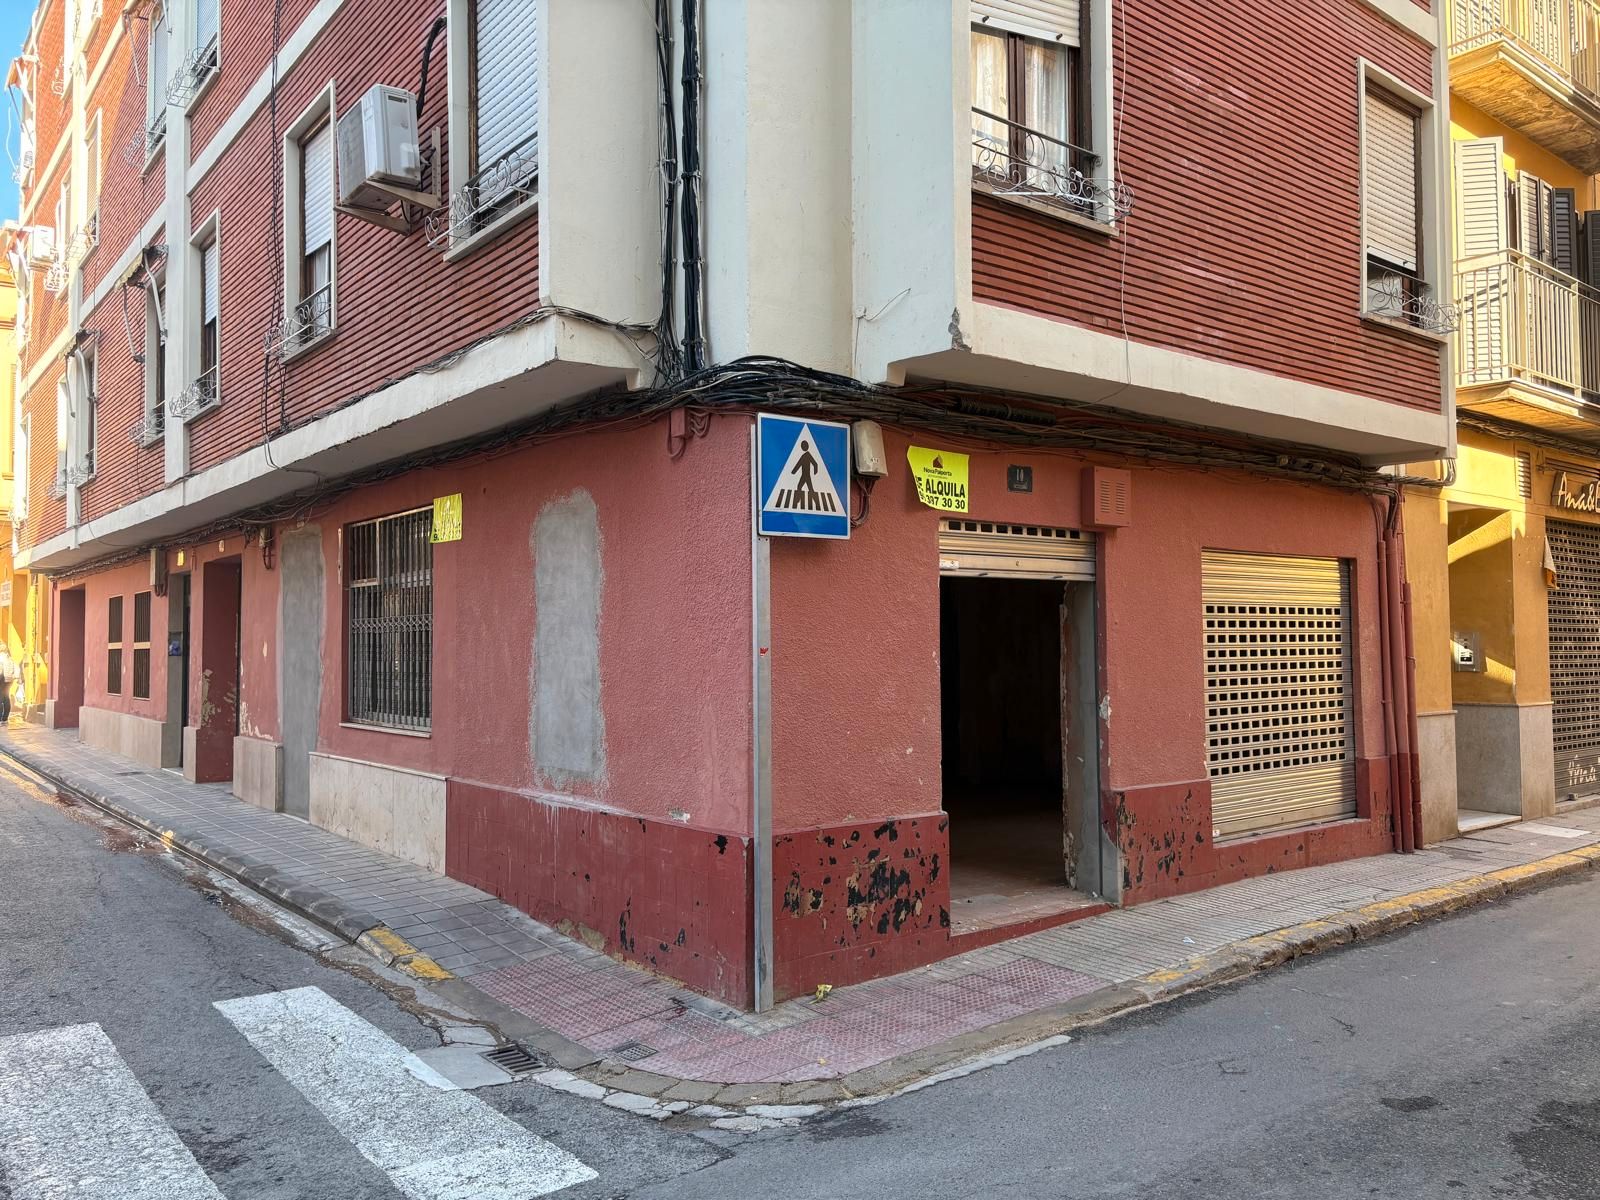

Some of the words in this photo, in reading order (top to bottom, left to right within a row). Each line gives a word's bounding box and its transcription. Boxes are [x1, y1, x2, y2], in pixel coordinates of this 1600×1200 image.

[925, 479, 965, 498] ALQUILA
[942, 498, 953, 508] 30
[955, 499, 966, 510] 30
